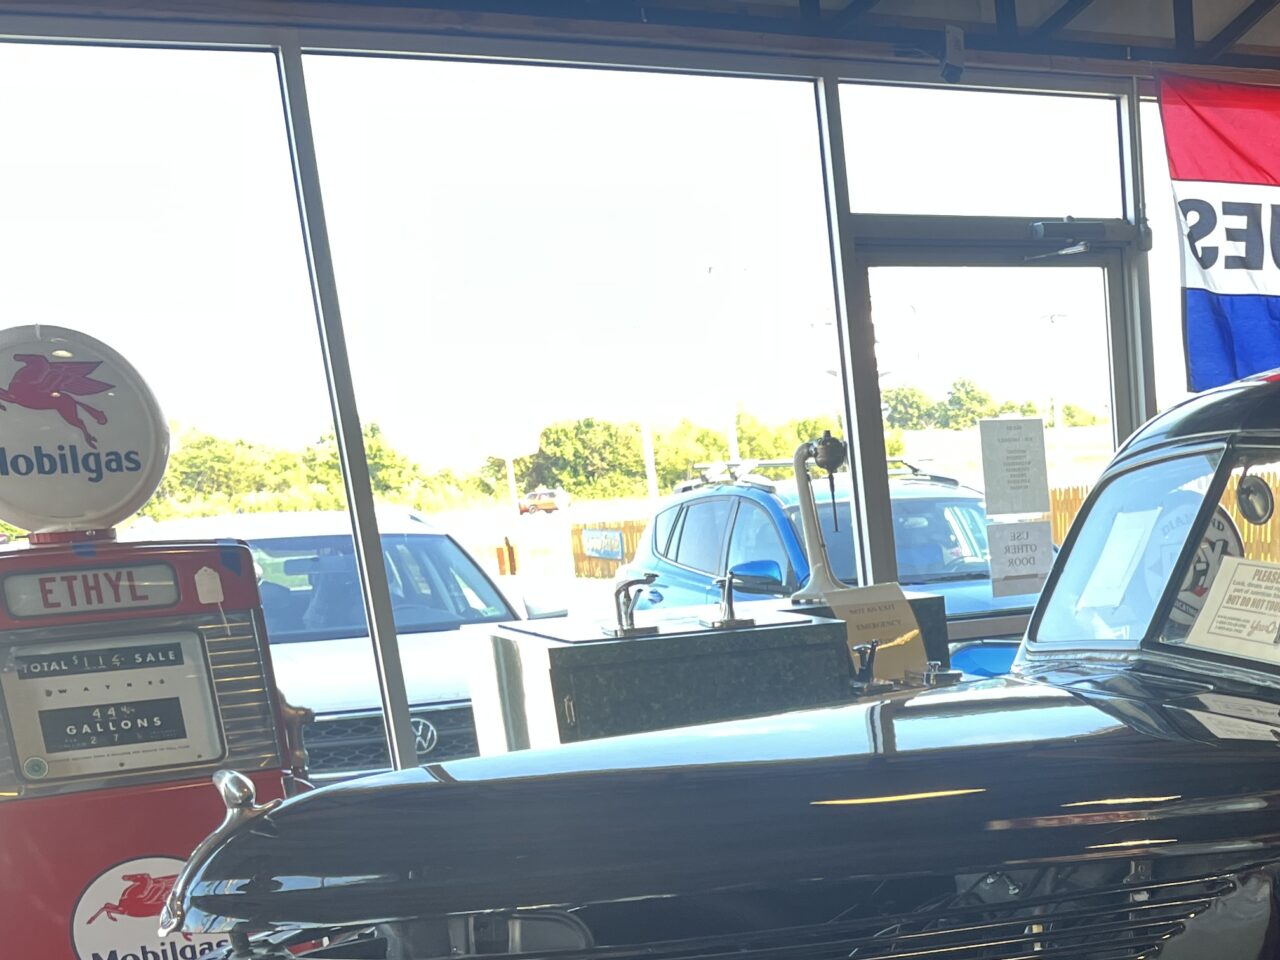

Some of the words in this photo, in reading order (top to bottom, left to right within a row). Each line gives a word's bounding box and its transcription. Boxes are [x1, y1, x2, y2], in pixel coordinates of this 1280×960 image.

[38, 570, 149, 609] ETHYL
[22, 660, 68, 674] TOTAL
[134, 650, 176, 664] SALE
[66, 716, 162, 735] GALLONS
